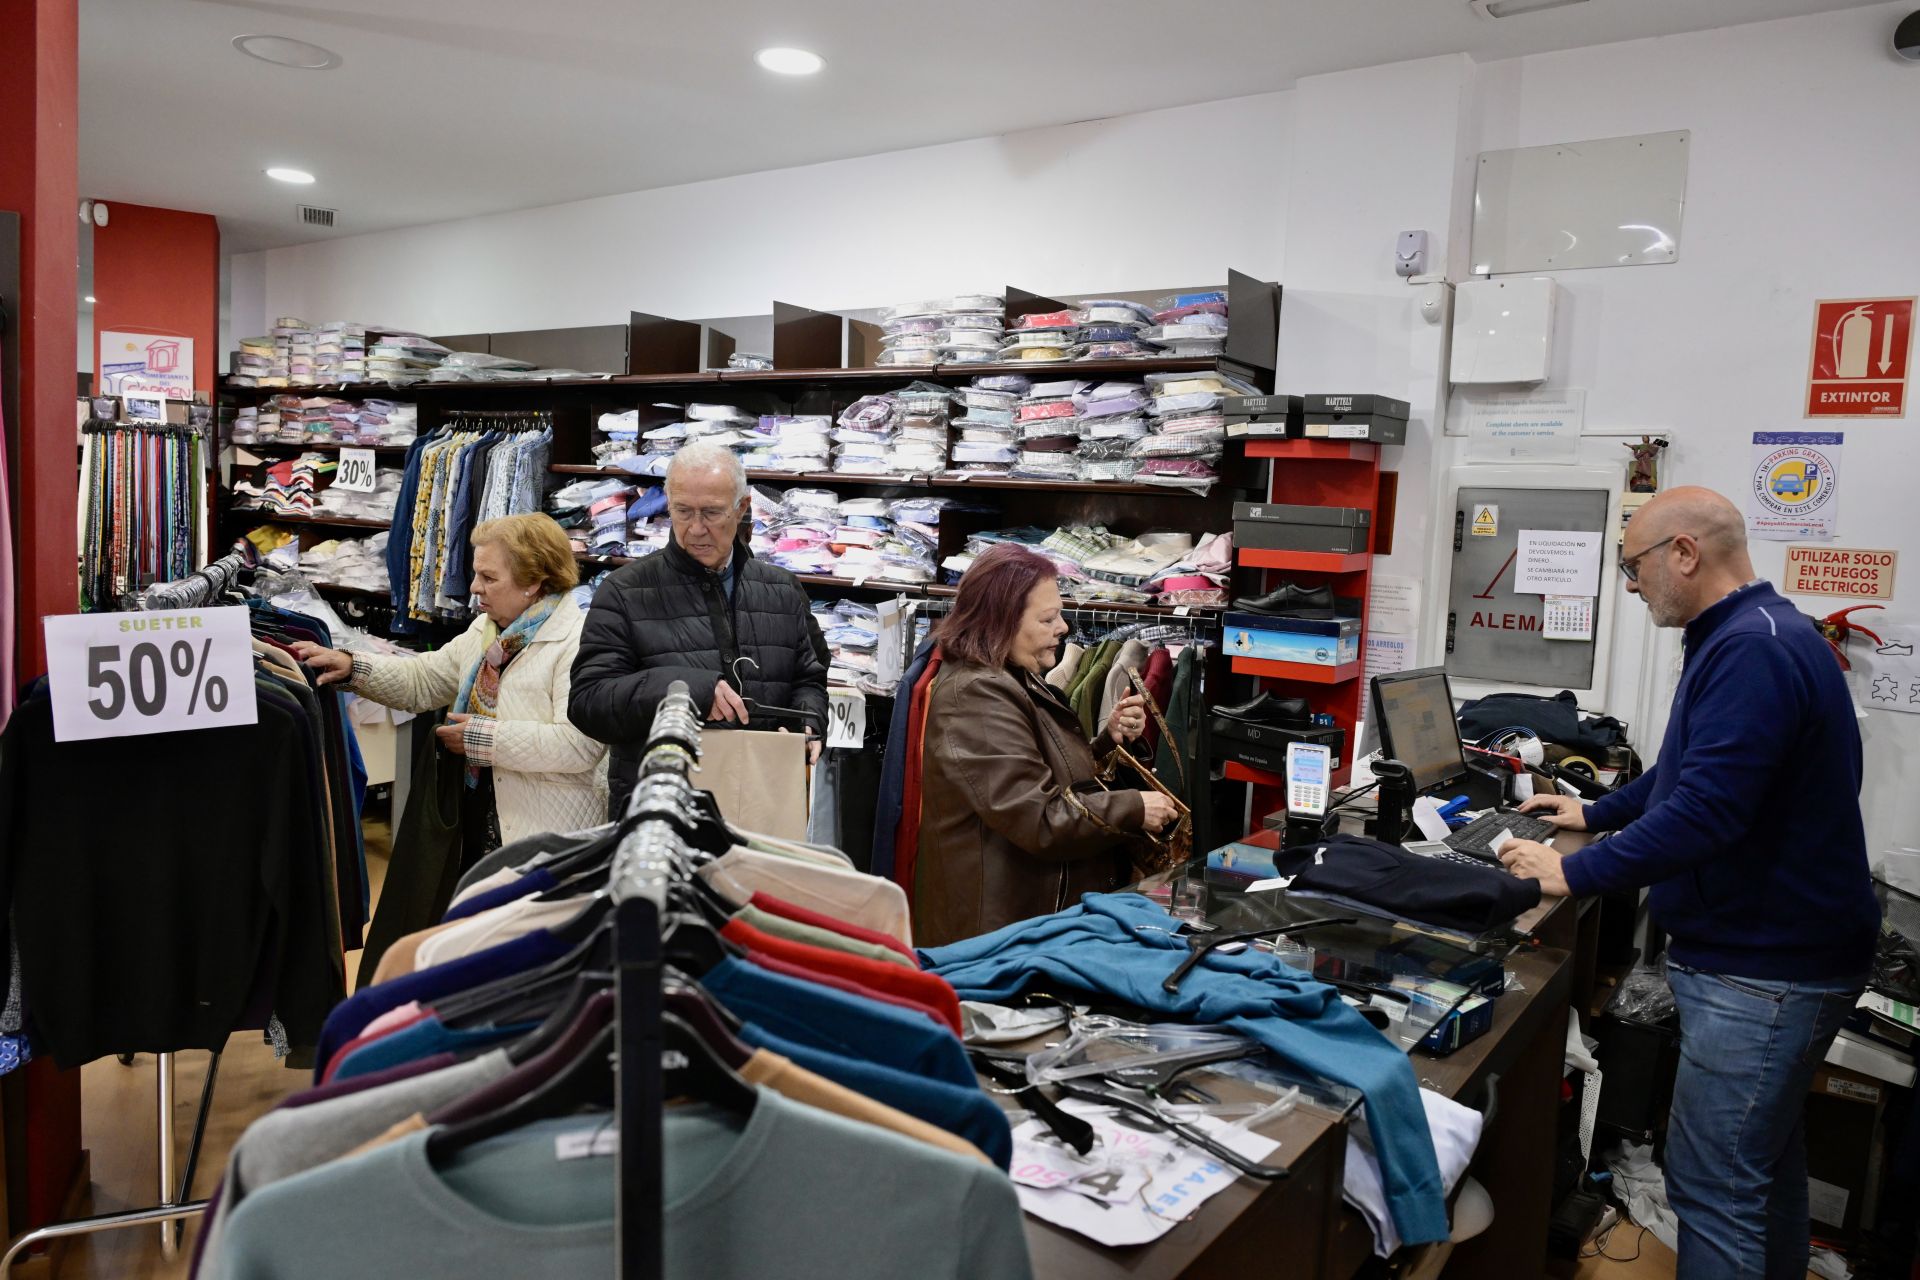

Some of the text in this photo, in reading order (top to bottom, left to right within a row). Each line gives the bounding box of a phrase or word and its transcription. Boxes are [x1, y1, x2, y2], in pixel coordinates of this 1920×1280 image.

[1820, 391, 1891, 403] EXTINTOR
[1802, 450, 1830, 474] GRATUITO
[1806, 465, 1816, 474] P
[339, 459, 372, 487] 30%
[1759, 492, 1782, 511] COMPRAR
[1795, 505, 1812, 513] ESTE
[1813, 482, 1832, 507] COMERCIO
[1791, 550, 1892, 566] UTILIZAR SOLO
[1800, 565, 1879, 580] EN FUEGOS
[1797, 579, 1878, 594] ELECTRICOS
[119, 615, 203, 632] SUETER
[1376, 640, 1404, 649] ARREGLOS
[87, 638, 229, 721] 50%
